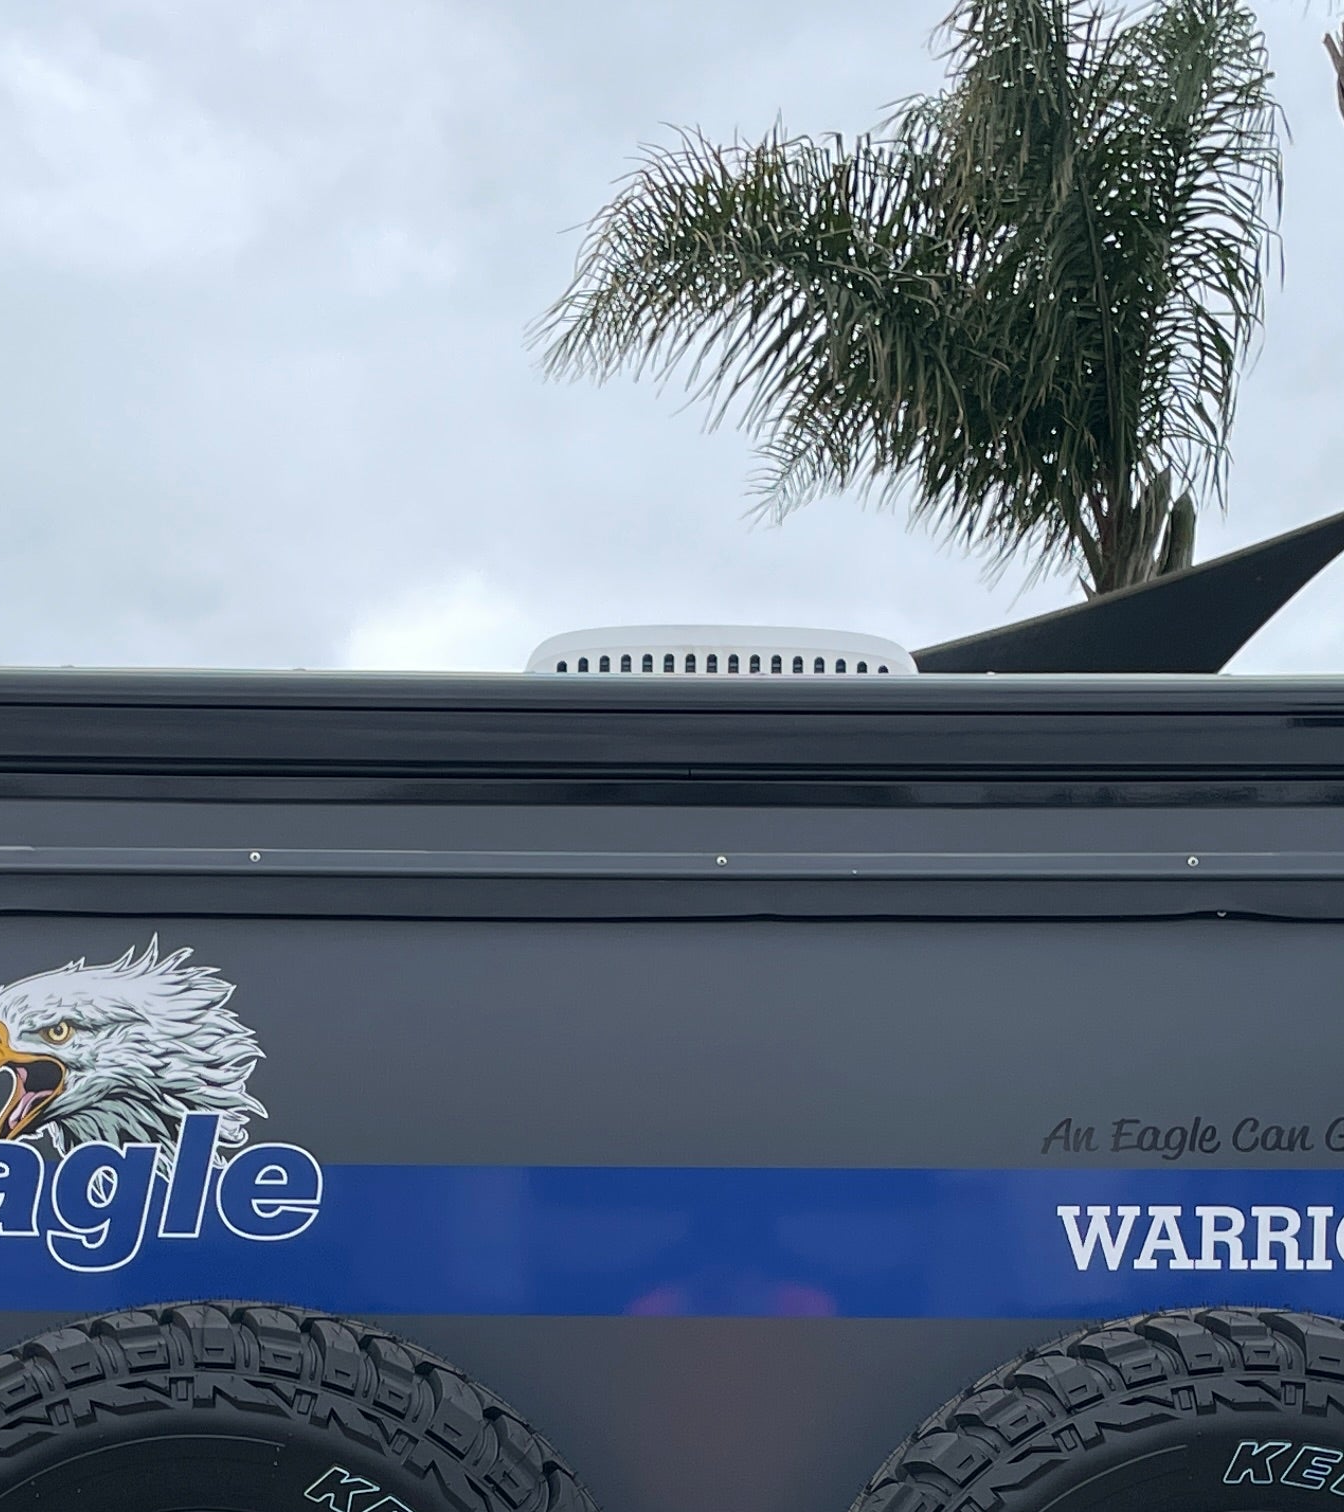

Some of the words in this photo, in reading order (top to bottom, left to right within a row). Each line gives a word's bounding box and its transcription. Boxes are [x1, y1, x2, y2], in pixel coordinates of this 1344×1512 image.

[1040, 1117, 1099, 1154] An
[1110, 1116, 1221, 1160] Eagle
[1232, 1117, 1314, 1153] Can
